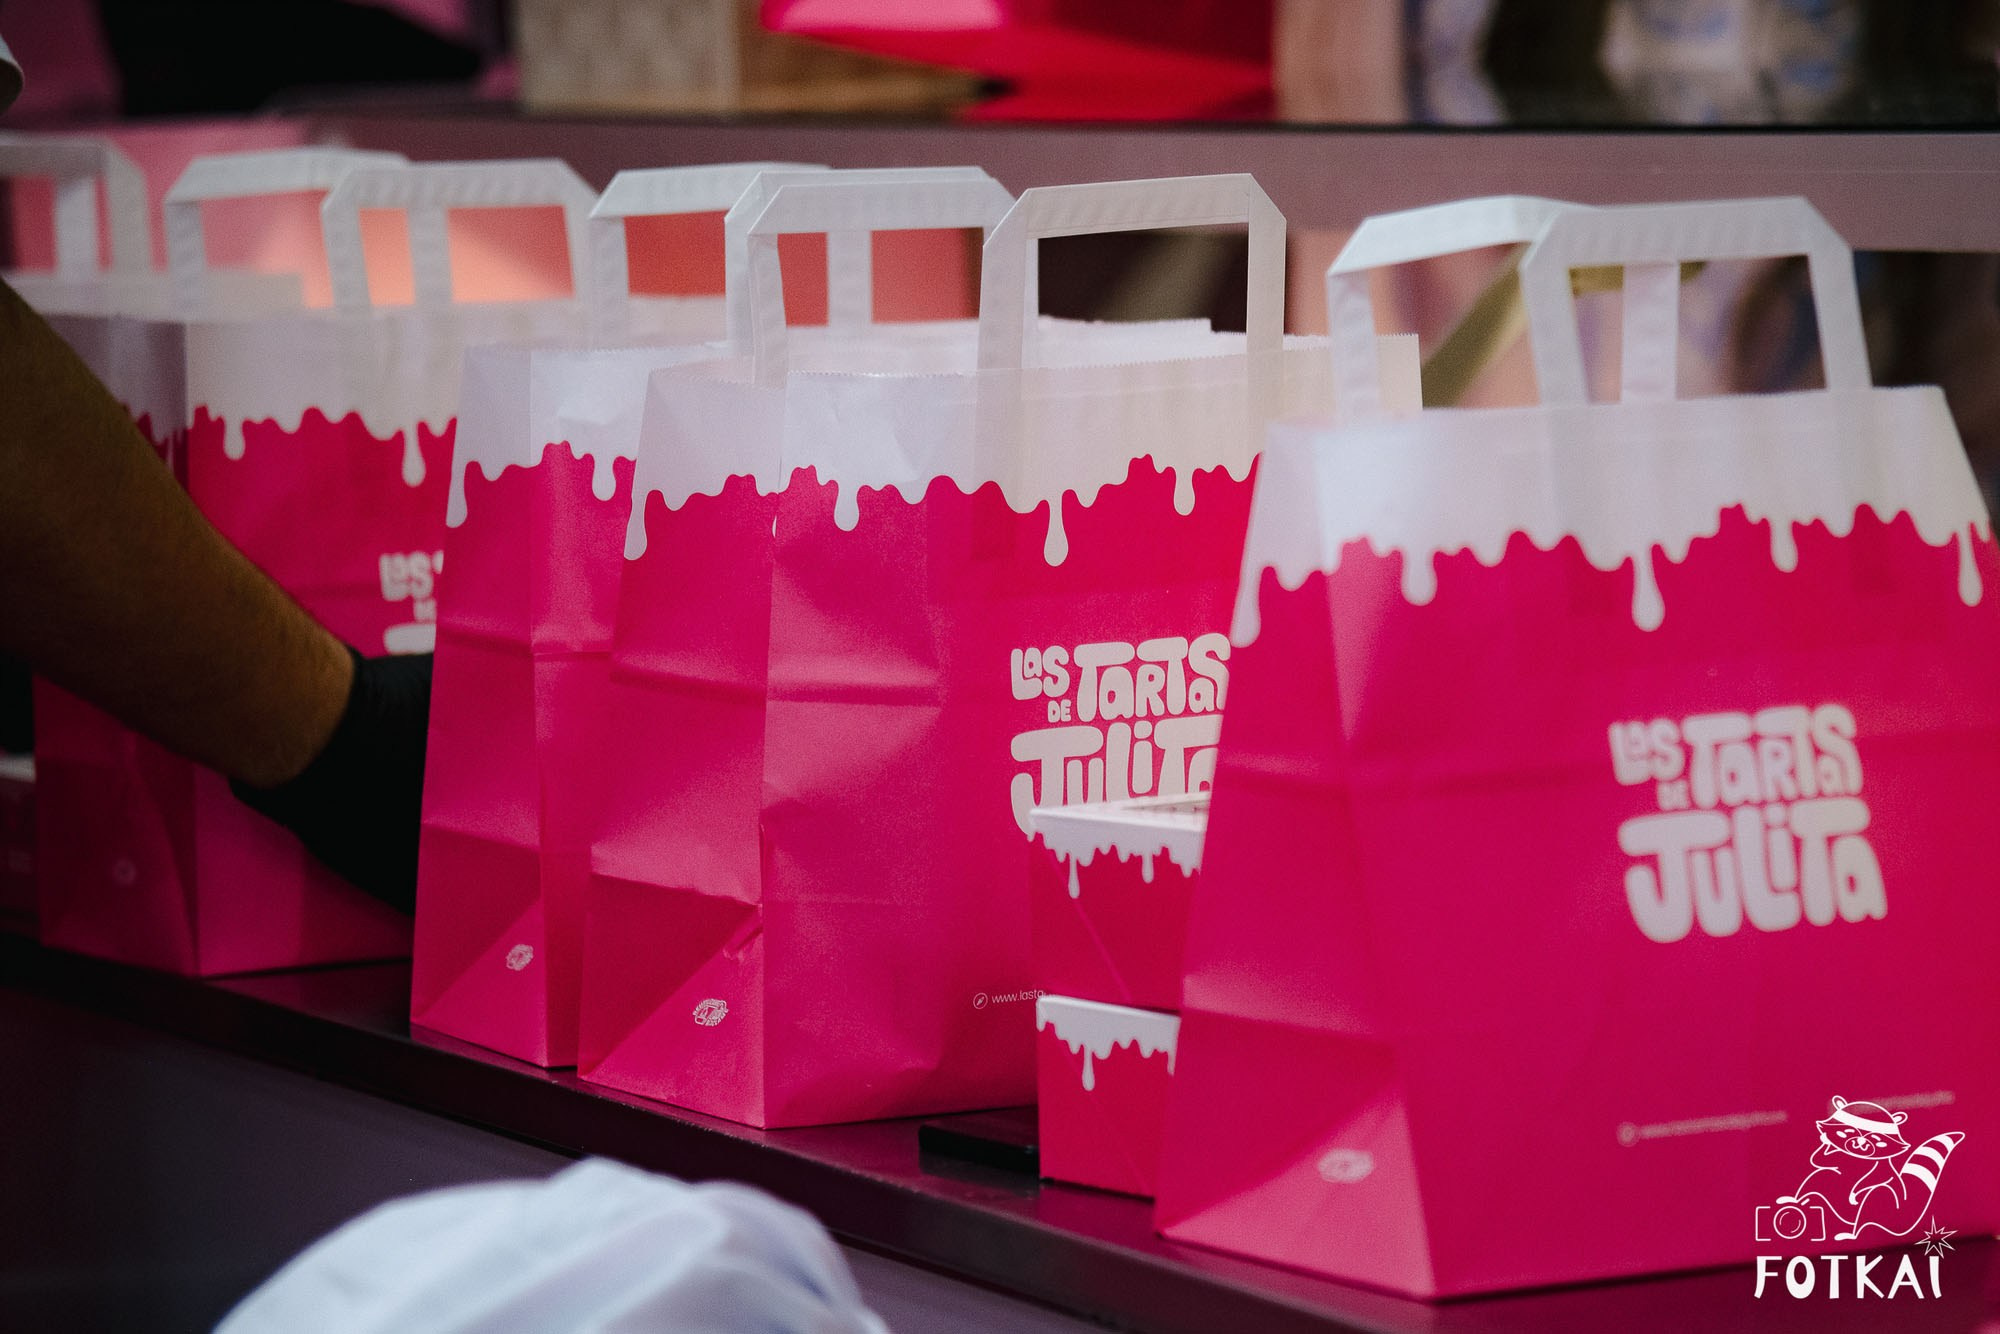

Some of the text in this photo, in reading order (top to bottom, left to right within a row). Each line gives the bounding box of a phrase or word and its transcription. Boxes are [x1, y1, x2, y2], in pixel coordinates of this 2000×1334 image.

[1011, 632, 1231, 723] LaS TaRTaS
[1047, 699, 1072, 723] DE
[1681, 702, 1864, 811] TaRTaS
[1617, 796, 1889, 944] JuLiTa
[991, 989, 1046, 1004] www.lasta
